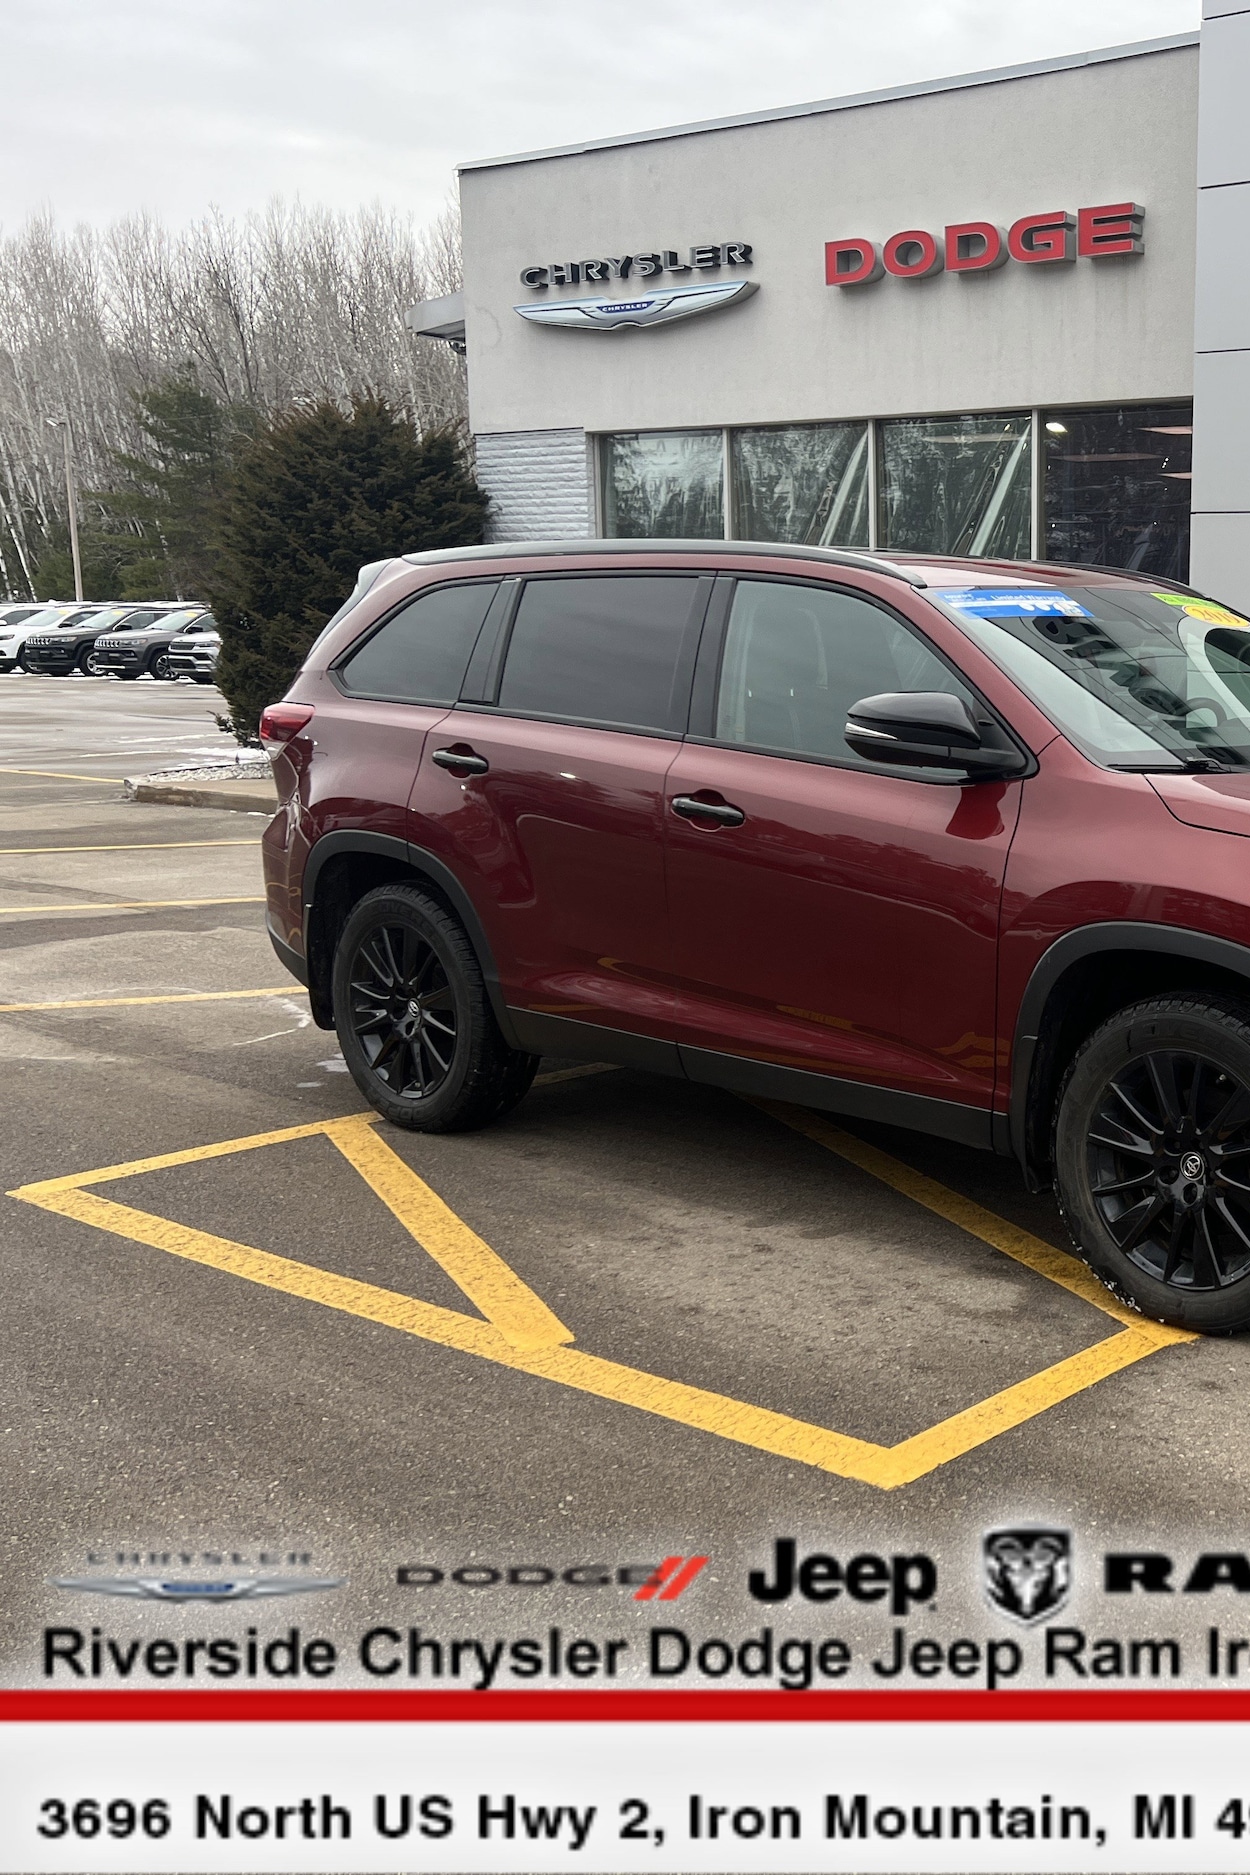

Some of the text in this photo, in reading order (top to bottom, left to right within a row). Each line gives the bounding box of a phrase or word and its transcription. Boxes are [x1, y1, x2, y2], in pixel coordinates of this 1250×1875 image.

[519, 241, 753, 289] CHRYSLER
[824, 202, 1143, 286] DODGE
[601, 303, 648, 312] CHRYSLER
